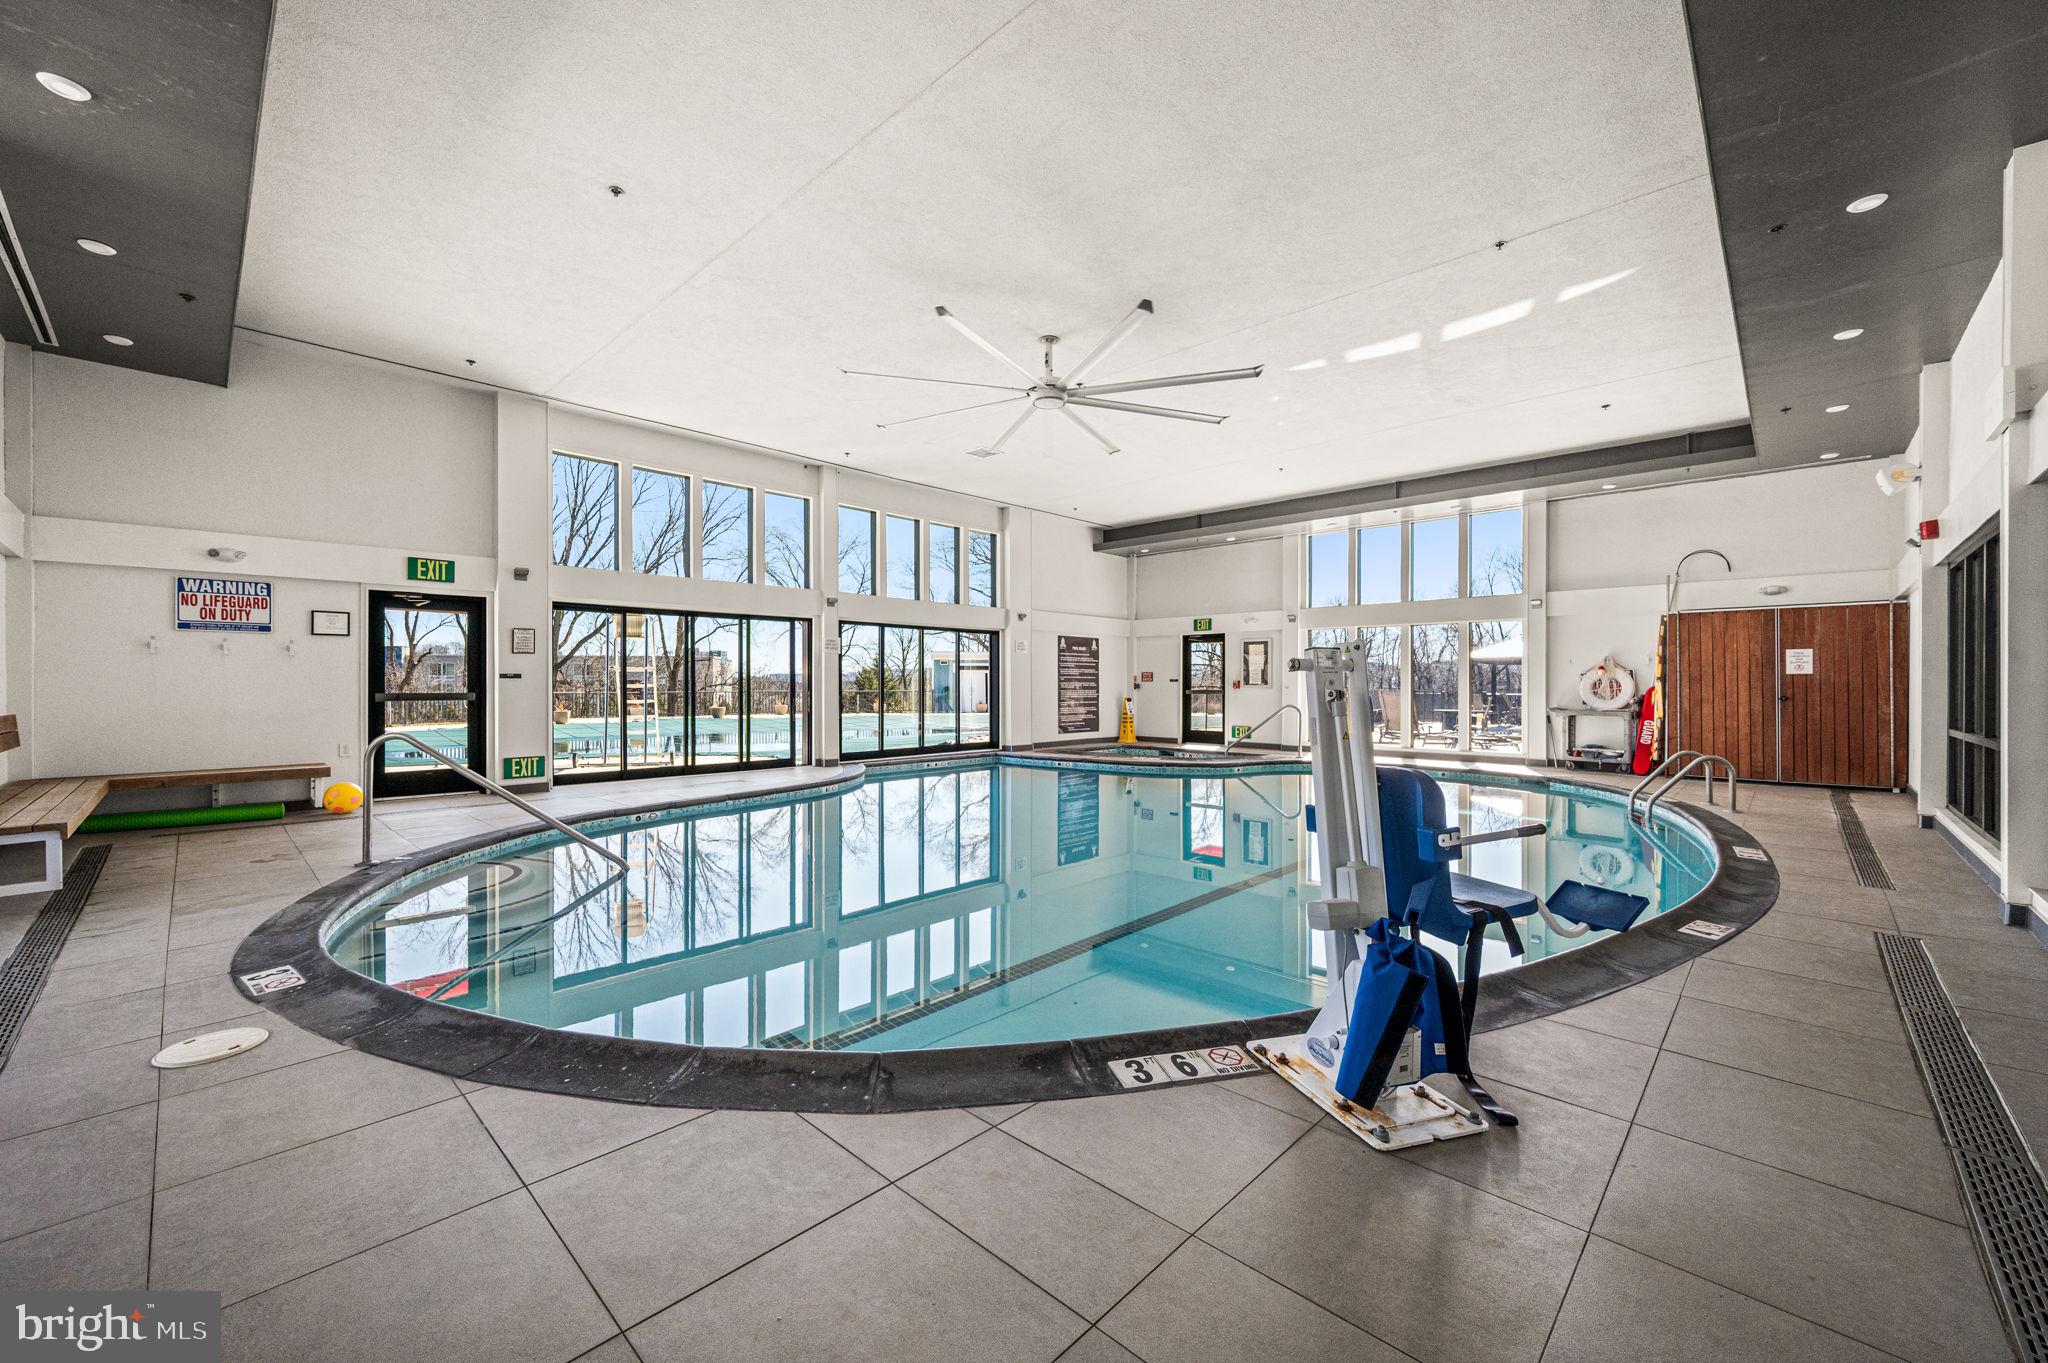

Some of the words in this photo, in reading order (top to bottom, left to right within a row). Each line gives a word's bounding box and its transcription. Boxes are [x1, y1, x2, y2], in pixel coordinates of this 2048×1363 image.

[417, 559, 449, 581] EXIT
[182, 578, 268, 596] WARNING
[181, 593, 198, 607] NO
[203, 594, 269, 610] LIFEGUARD
[200, 607, 217, 621] ON
[221, 608, 252, 622] DUTY
[1197, 619, 1209, 631] EXIT
[1640, 719, 1655, 745] GUARD
[511, 757, 539, 778] EXIT
[1124, 1059, 1154, 1084] 3
[1143, 1056, 1156, 1065] FT
[1170, 1053, 1199, 1078] 6
[1186, 1049, 1200, 1060] IN
[1216, 1066, 1230, 1075] NO
[1230, 1062, 1259, 1073] DIVING
